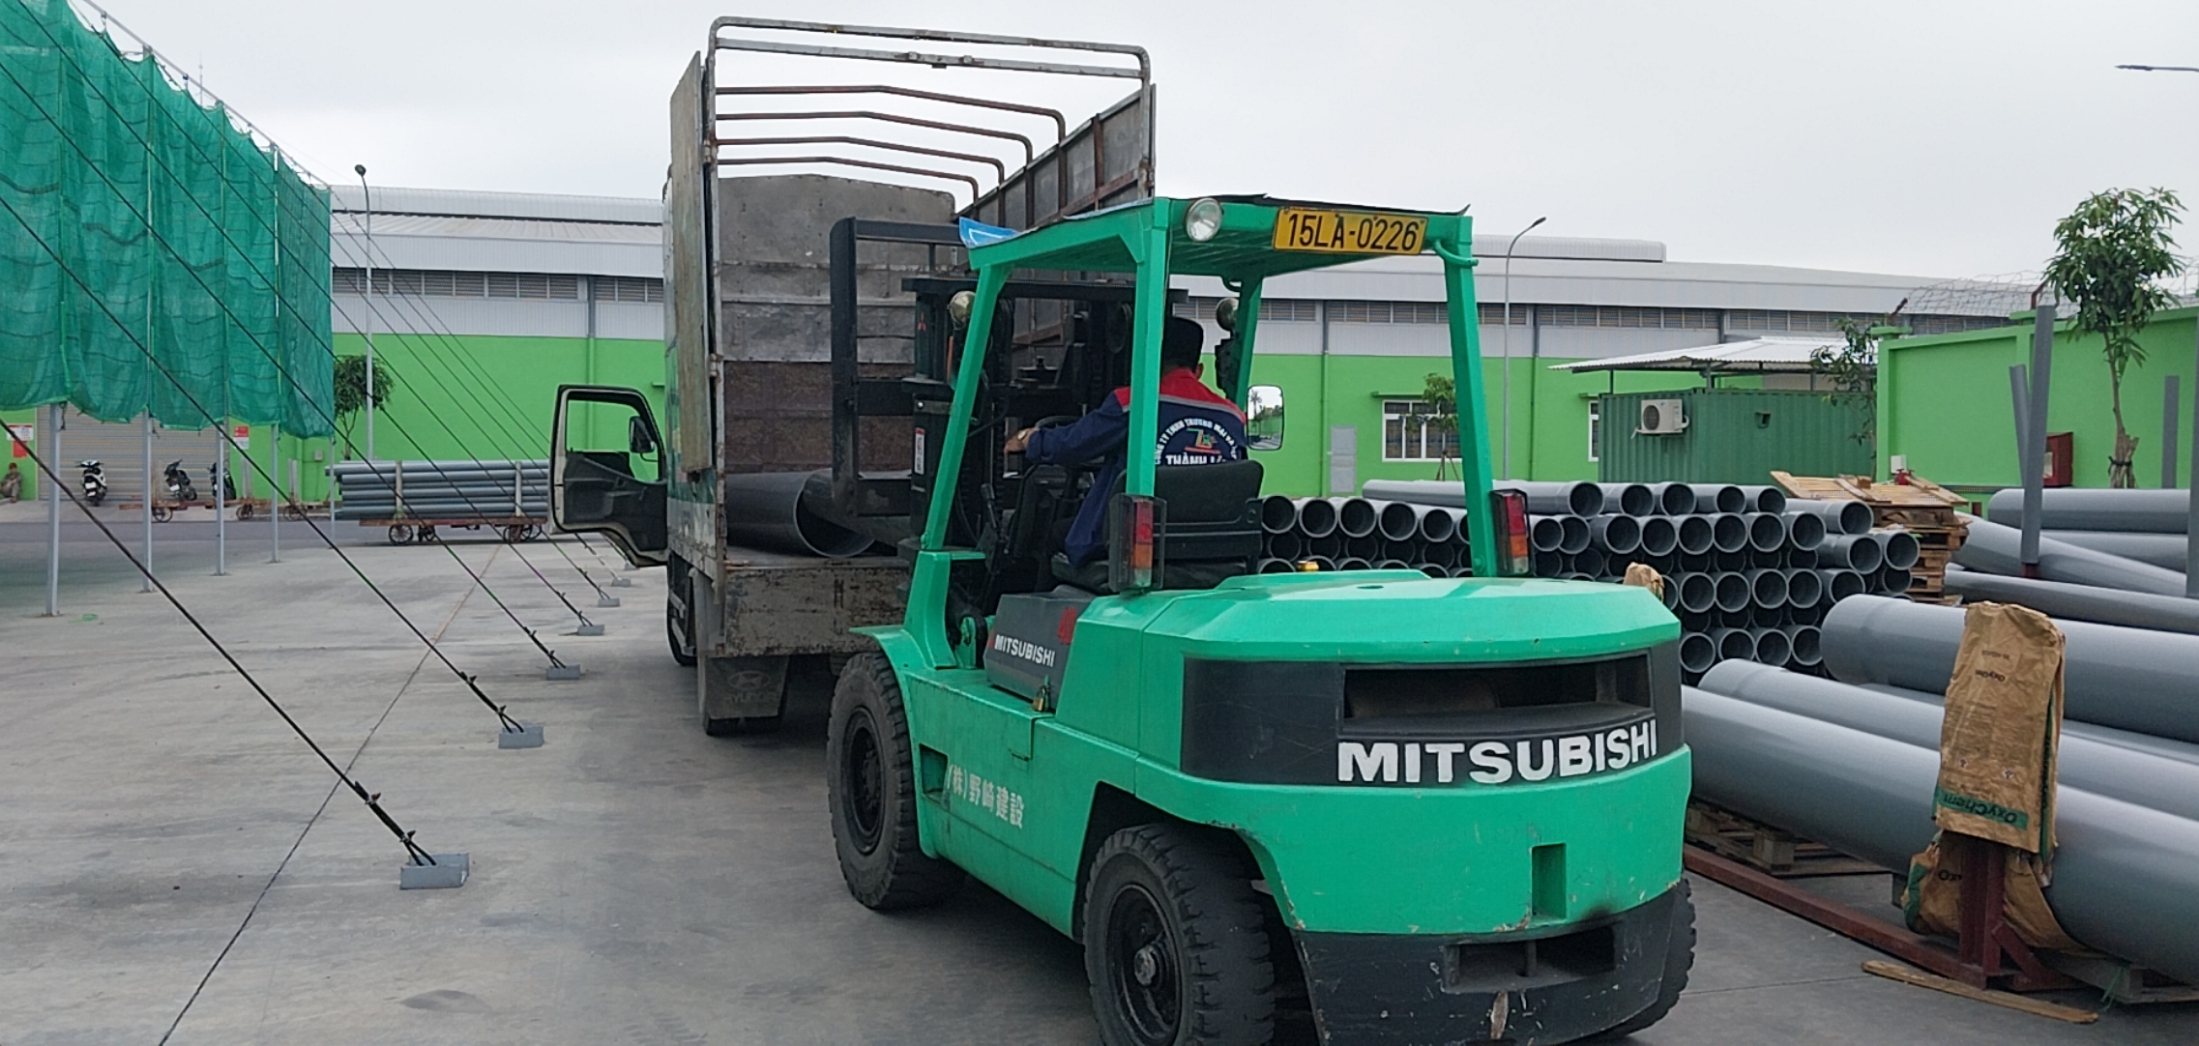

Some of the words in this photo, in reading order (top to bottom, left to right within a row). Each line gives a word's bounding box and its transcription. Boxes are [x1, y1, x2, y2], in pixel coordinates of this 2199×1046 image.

[1288, 213, 1419, 251] 15LA-0226
[994, 634, 1056, 668] MITSUBISHI
[1338, 719, 1657, 784] MITSUBISHI
[1943, 793, 2018, 824] OxyChem
